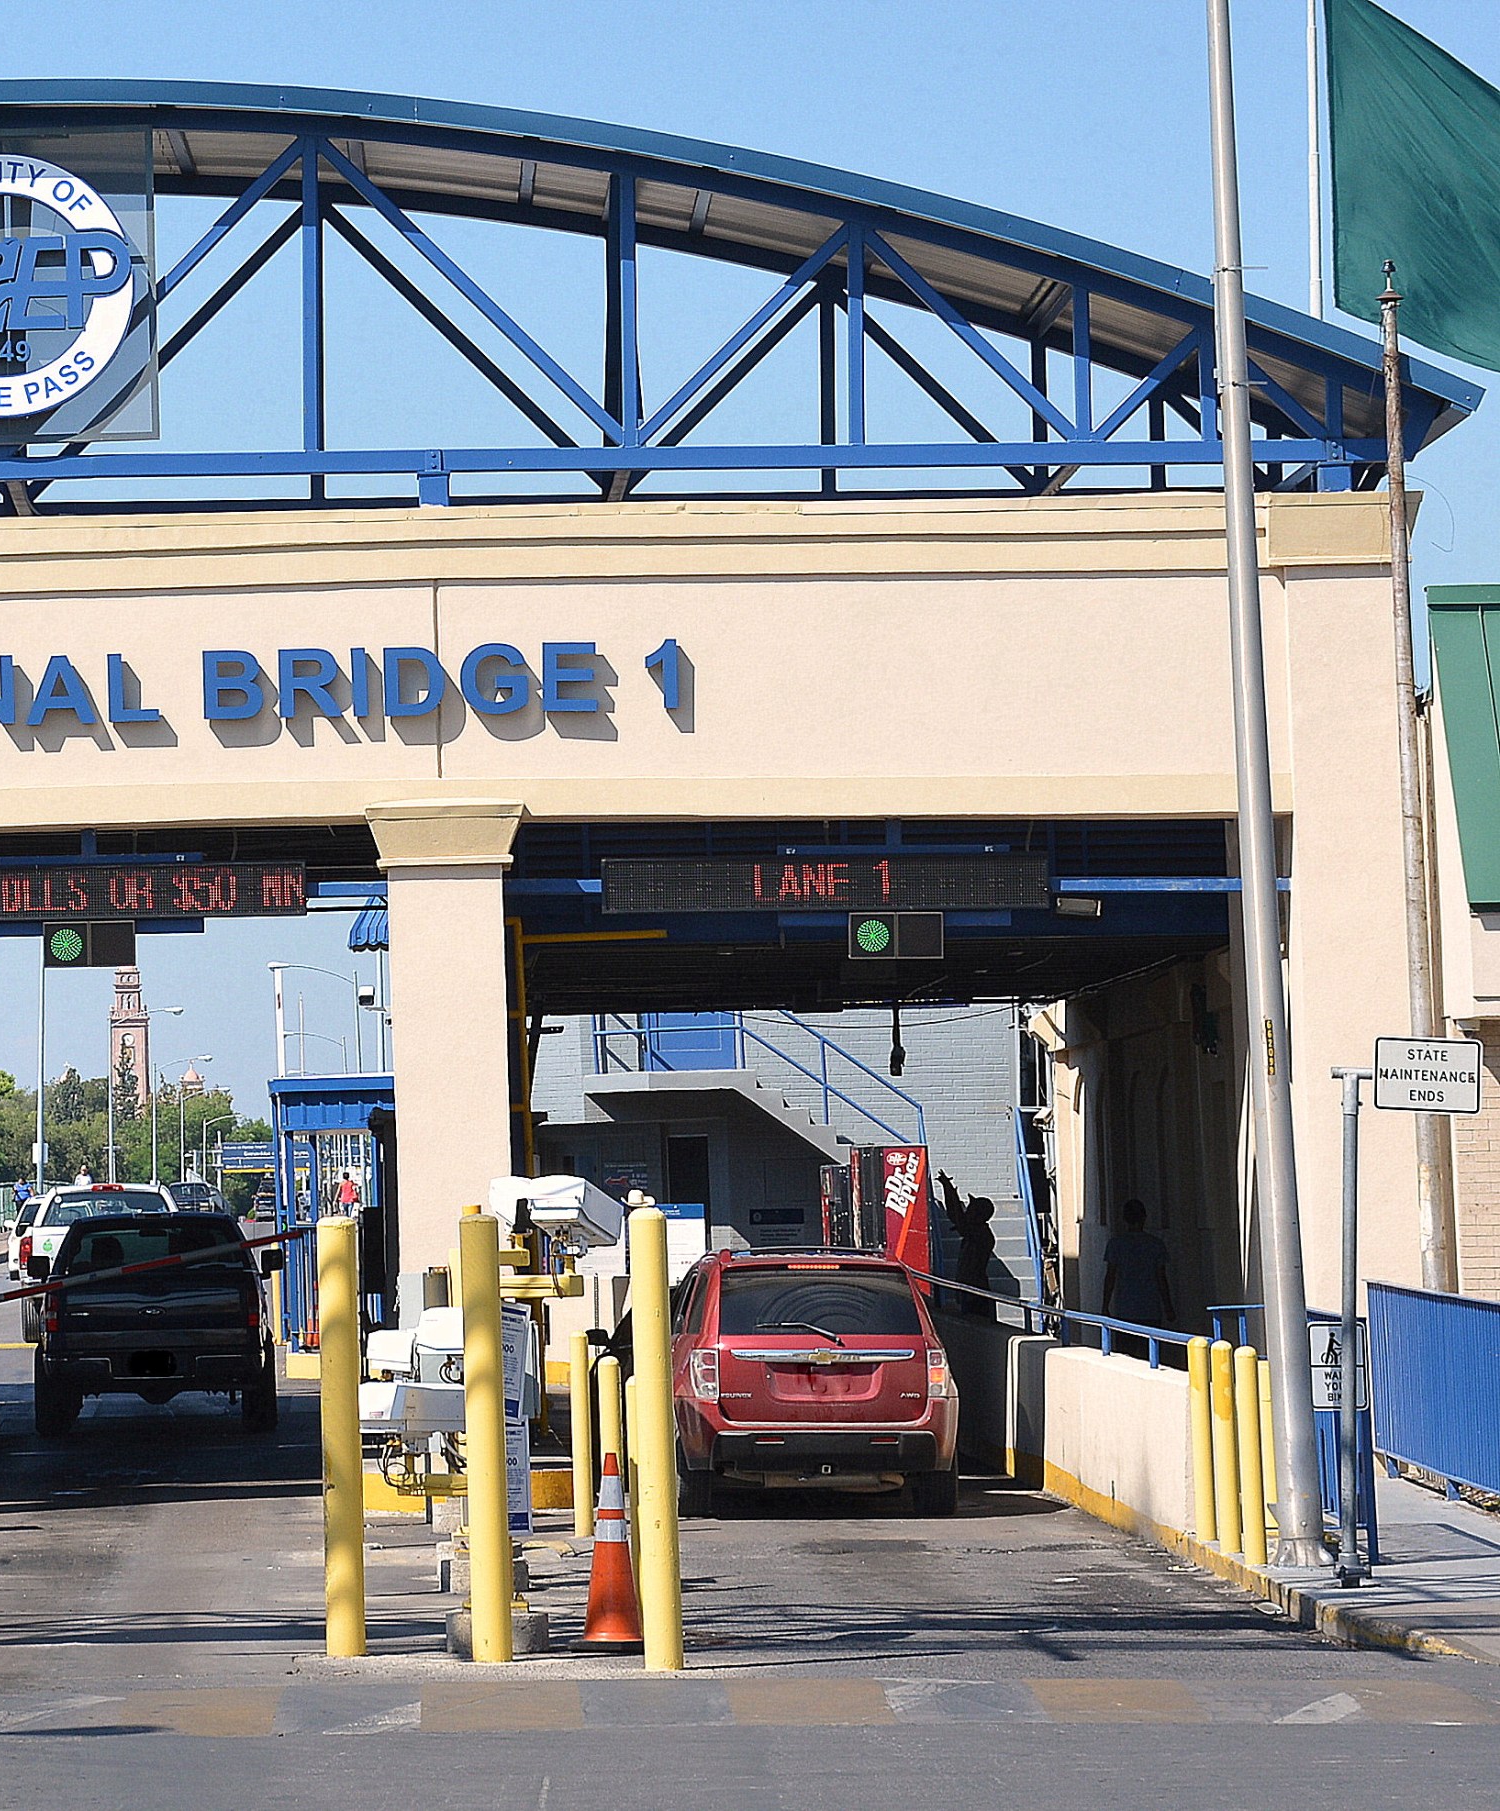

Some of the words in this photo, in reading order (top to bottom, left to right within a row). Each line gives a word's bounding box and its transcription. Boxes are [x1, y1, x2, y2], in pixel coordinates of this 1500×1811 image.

[52, 180, 93, 214] OF
[24, 350, 95, 404] PASS
[202, 641, 598, 720] BRIDGE
[645, 639, 680, 709] 1
[753, 863, 849, 902] LANE
[873, 859, 890, 902] 1
[1407, 1049, 1448, 1061] STATE
[1379, 1068, 1475, 1083] MAINTENANCE
[1409, 1090, 1444, 1102] ENDS
[885, 1166, 904, 1194] Dr
